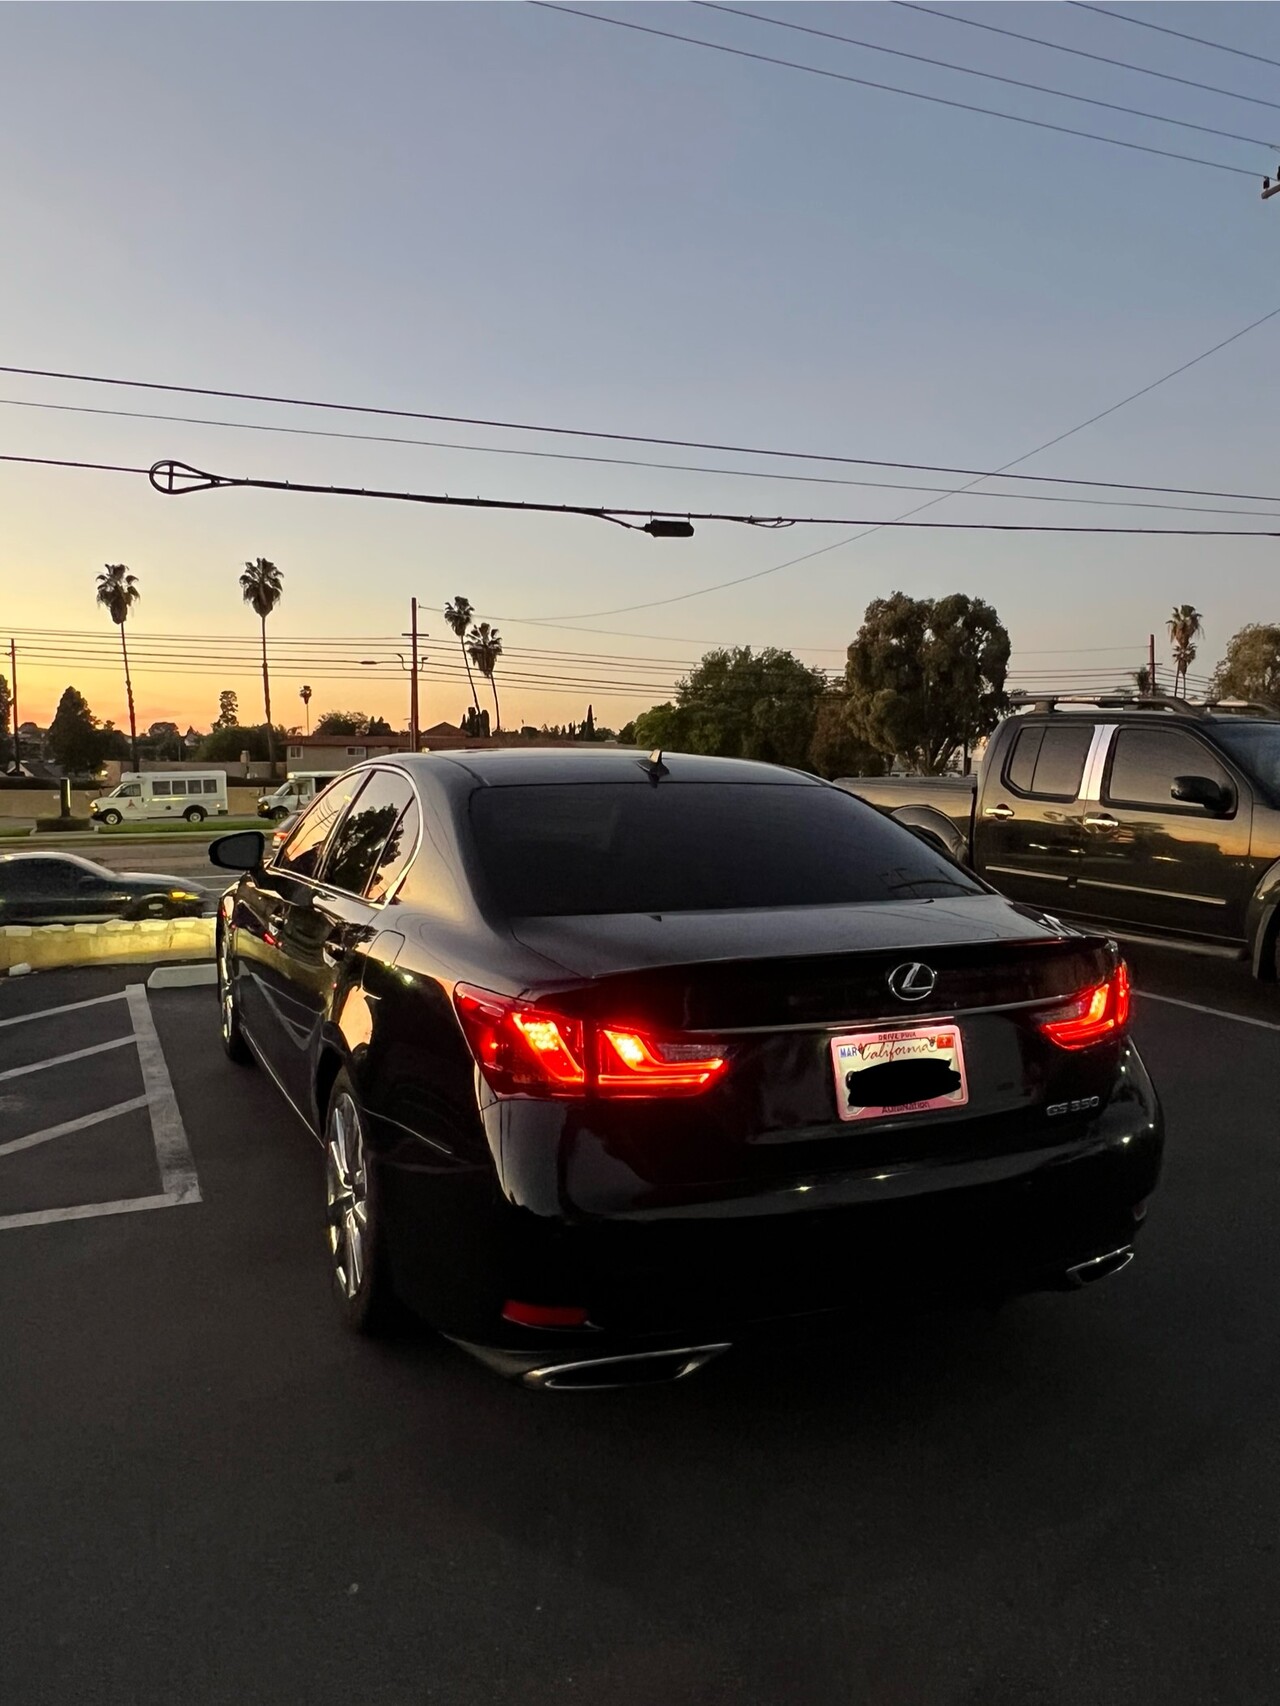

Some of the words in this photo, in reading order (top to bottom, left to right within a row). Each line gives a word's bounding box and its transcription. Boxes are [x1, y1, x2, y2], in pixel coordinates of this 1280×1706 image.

[840, 1046, 858, 1058] MAR
[861, 1040, 930, 1062] California
[1046, 1102, 1069, 1116] GS
